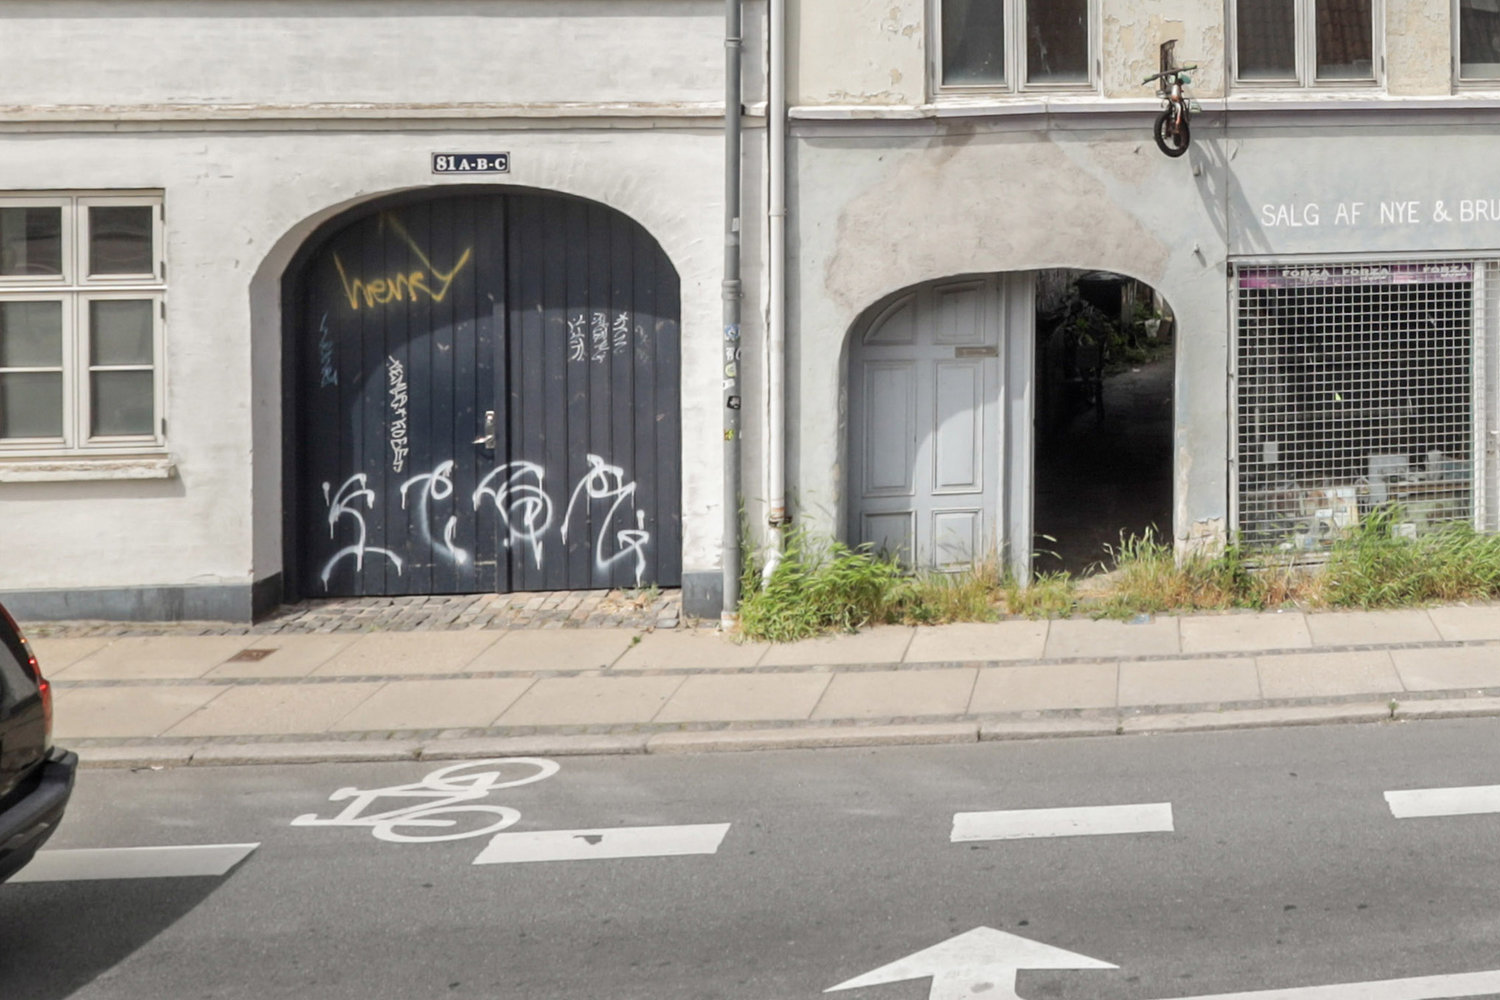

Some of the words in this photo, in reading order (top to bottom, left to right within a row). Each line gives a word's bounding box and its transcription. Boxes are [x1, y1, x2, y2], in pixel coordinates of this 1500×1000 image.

[436, 156, 456, 170] 81
[459, 158, 506, 170] A-B-C
[1261, 203, 1320, 227] SALG
[1334, 202, 1364, 225] AF
[1380, 201, 1421, 224] NYE
[1432, 199, 1453, 222] &
